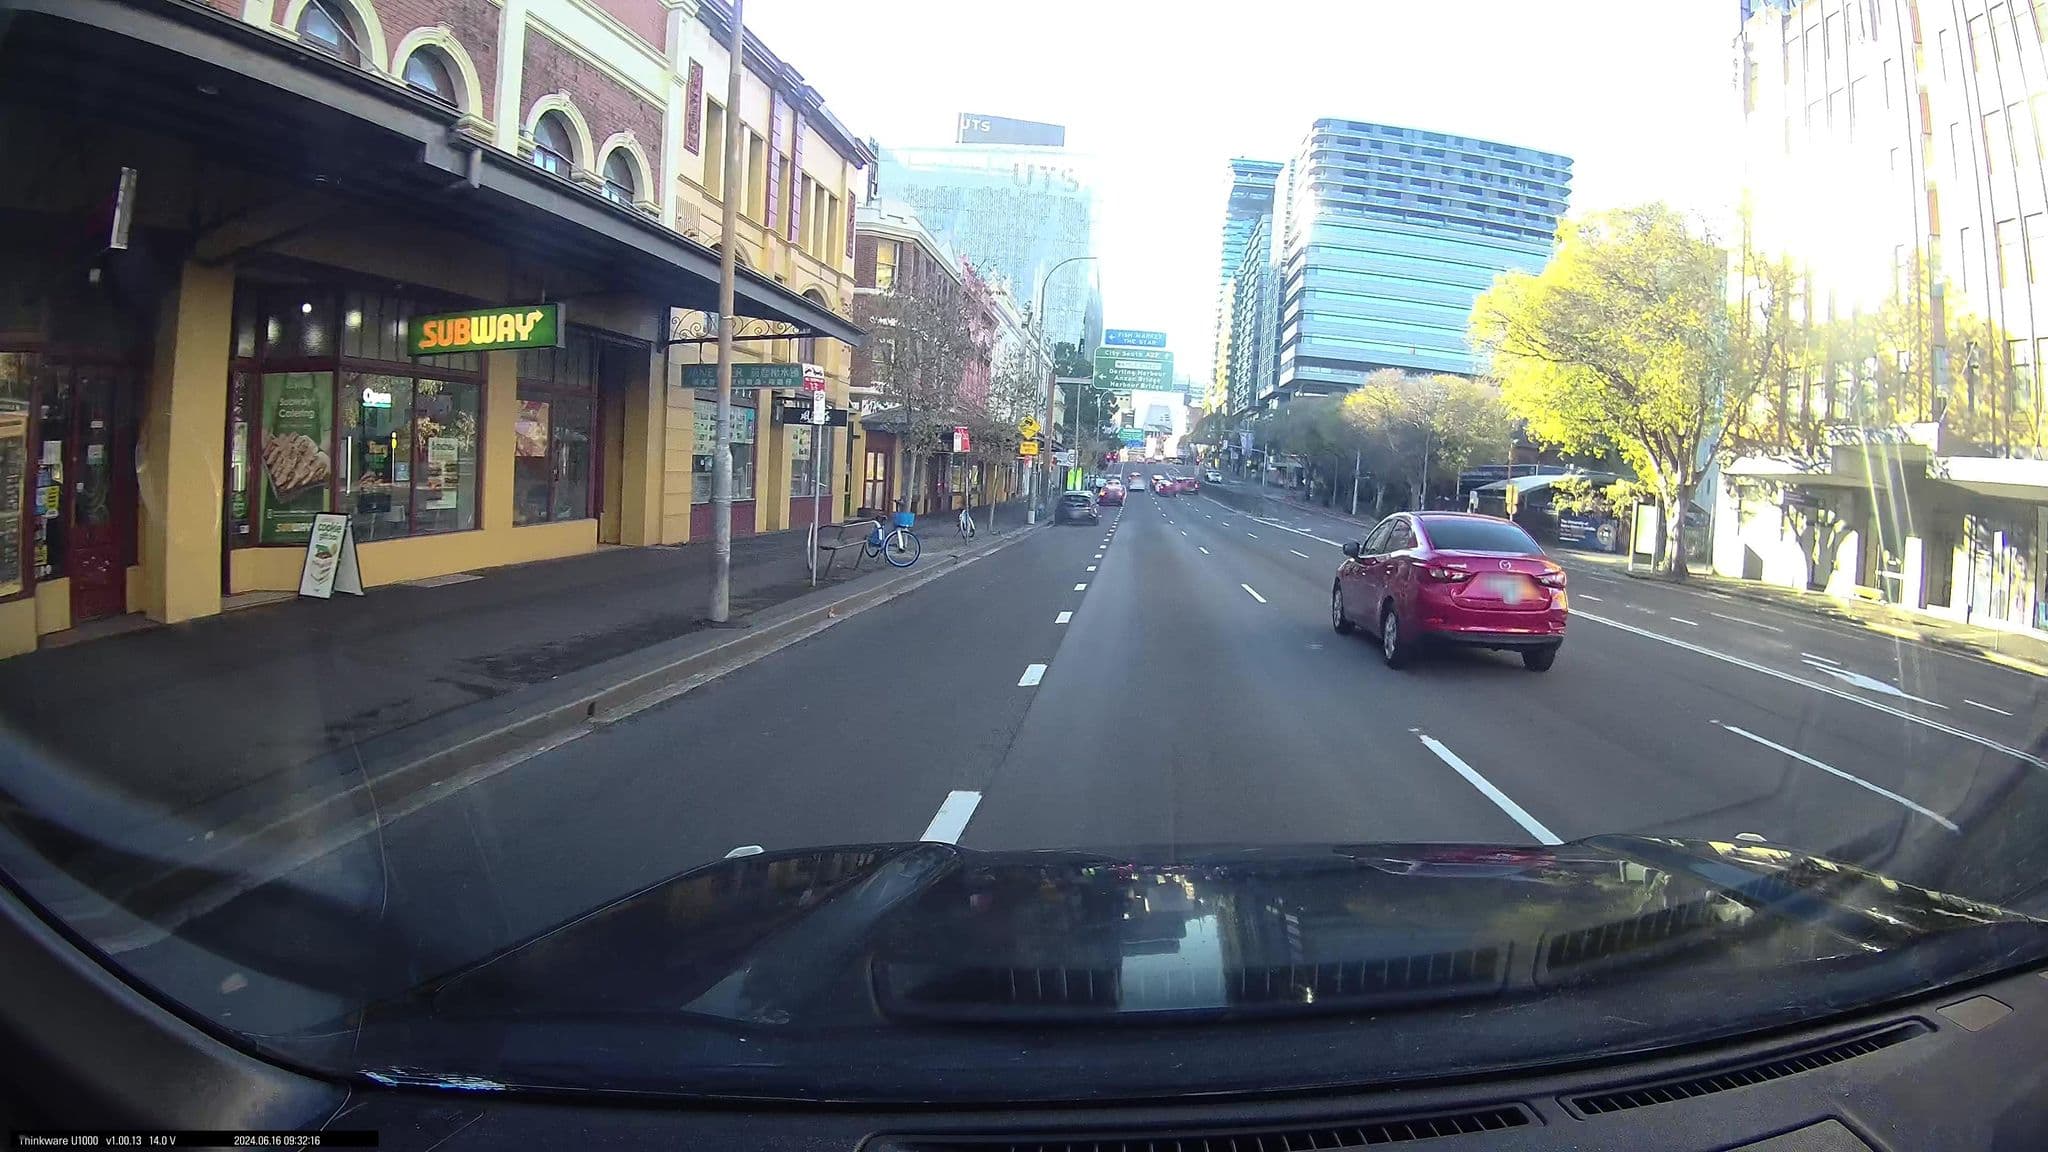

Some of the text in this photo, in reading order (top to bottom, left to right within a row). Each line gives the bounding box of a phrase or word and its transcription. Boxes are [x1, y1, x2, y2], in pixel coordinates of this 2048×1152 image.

[418, 309, 544, 349] SUBWAY
[1109, 368, 1136, 377] Darling
[1141, 382, 1164, 390] Bridge
[363, 388, 392, 404] Open
[278, 409, 316, 419] Catering
[318, 522, 342, 533] cookie
